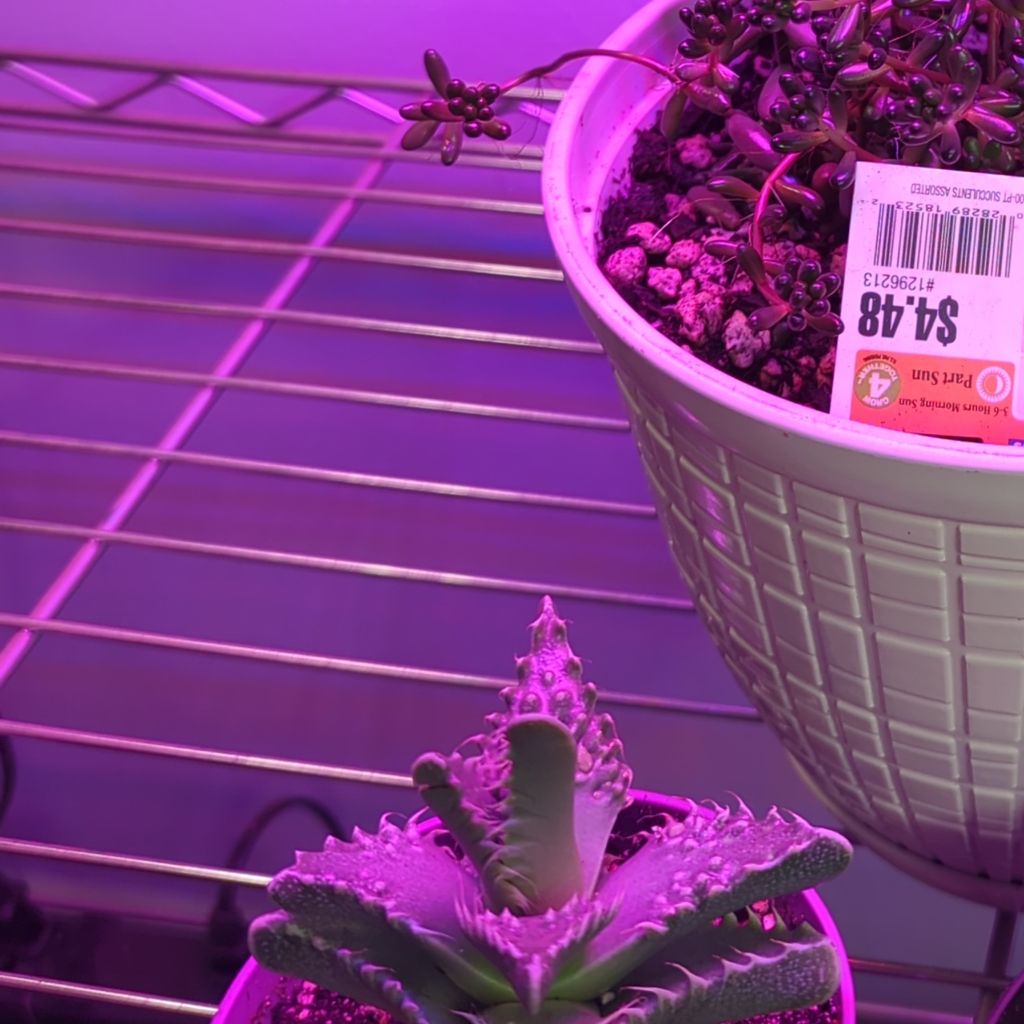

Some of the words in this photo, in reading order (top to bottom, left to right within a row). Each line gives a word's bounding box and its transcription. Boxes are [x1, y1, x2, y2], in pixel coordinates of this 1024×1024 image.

[911, 183, 951, 197] ASSORTED
[952, 187, 1001, 203] SUCCULENTS
[895, 200, 942, 214] 18523
[952, 205, 1000, 218] 28289
[863, 272, 935, 292] #1296213
[858, 291, 958, 347] $4.48
[867, 372, 892, 398] 4
[911, 369, 940, 385] Sun
[942, 372, 973, 388] Part
[898, 398, 918, 409] Sun
[920, 397, 961, 414] Morning
[963, 404, 991, 415] Hours
[993, 406, 1009, 417] 3-6
